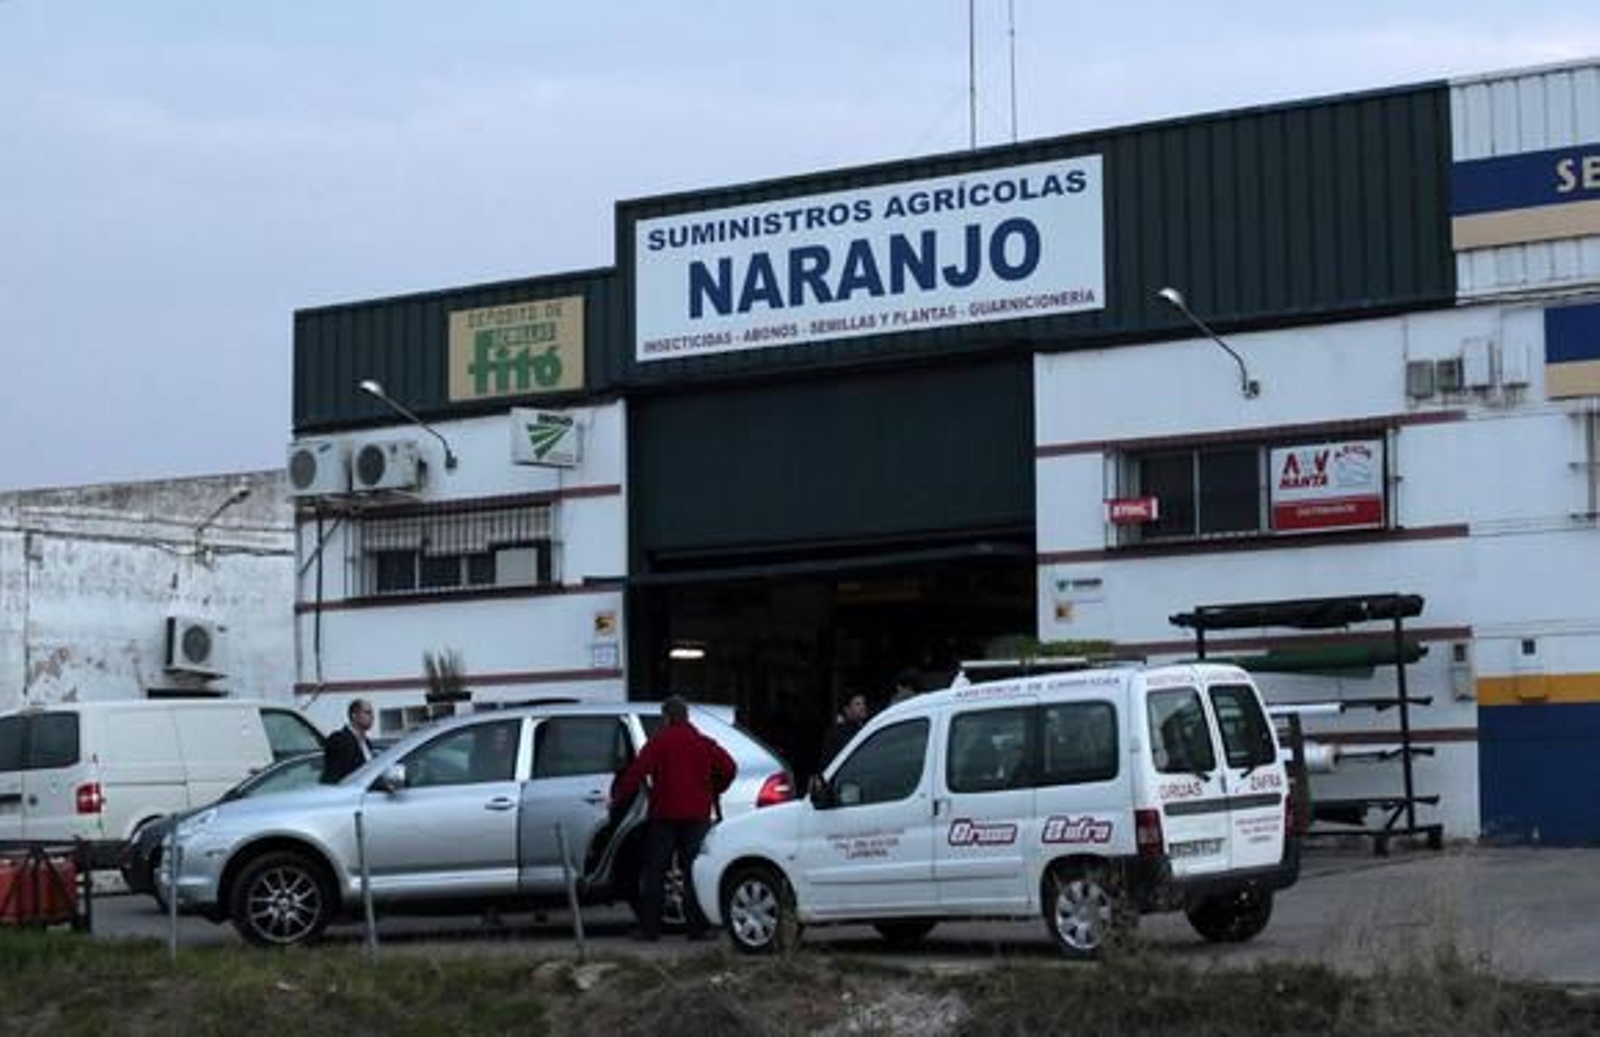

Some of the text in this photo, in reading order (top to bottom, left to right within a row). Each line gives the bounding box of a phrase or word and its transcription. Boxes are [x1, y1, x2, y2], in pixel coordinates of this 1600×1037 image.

[647, 170, 1087, 251] SUMINISTROS AGRÍCOLAS
[688, 217, 1041, 319] NARANJO
[644, 289, 1095, 353] INSECTICIDAS ABONOS SEMILLAS Y PLANTAS GUARNICIONERÍA
